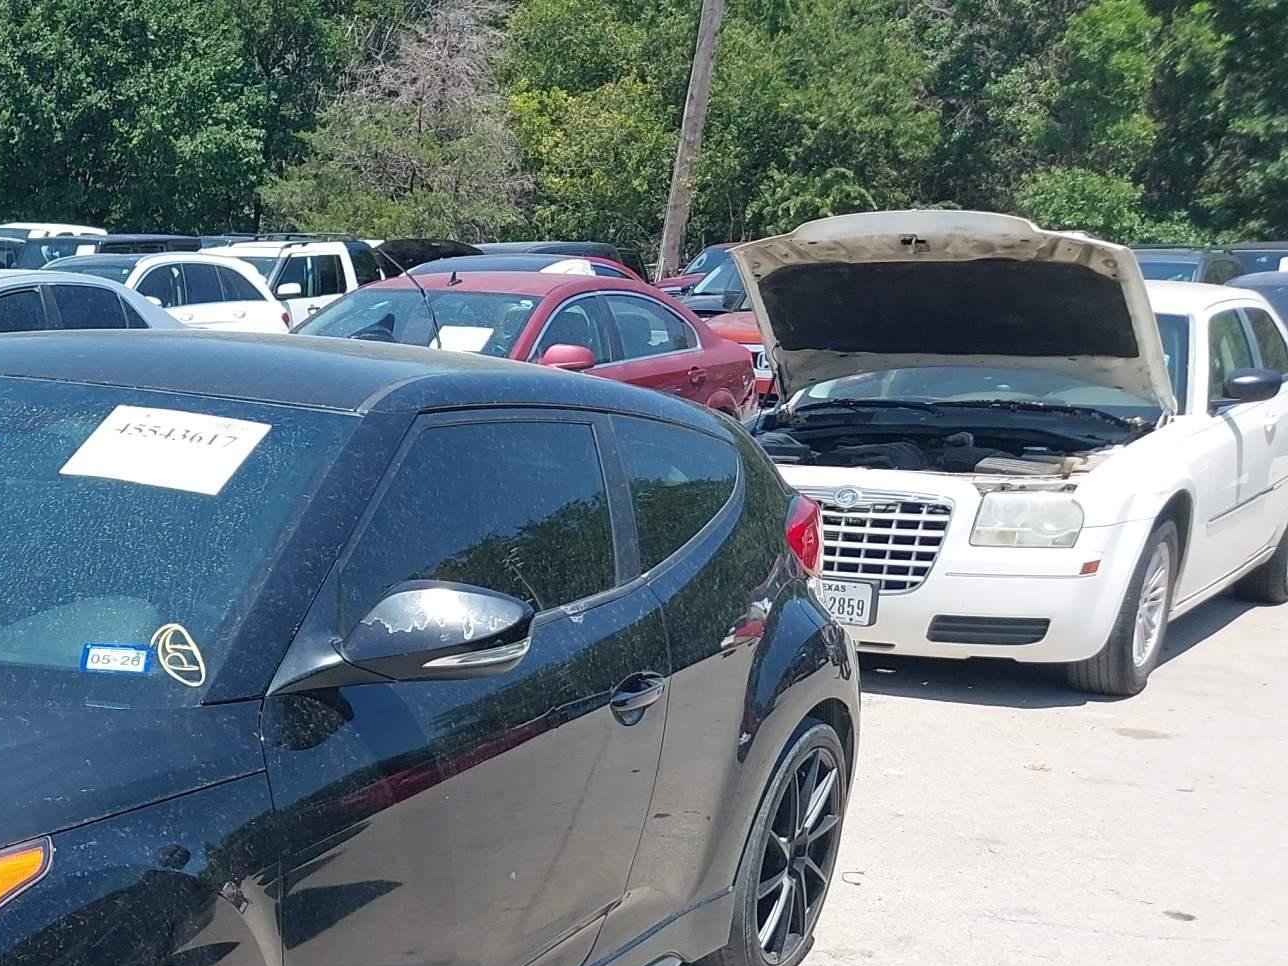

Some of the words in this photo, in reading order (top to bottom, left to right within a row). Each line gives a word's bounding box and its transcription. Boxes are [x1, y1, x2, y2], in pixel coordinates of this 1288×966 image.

[114, 422, 238, 448] 45543617
[823, 583, 847, 593] EXAS
[828, 596, 865, 617] 2859
